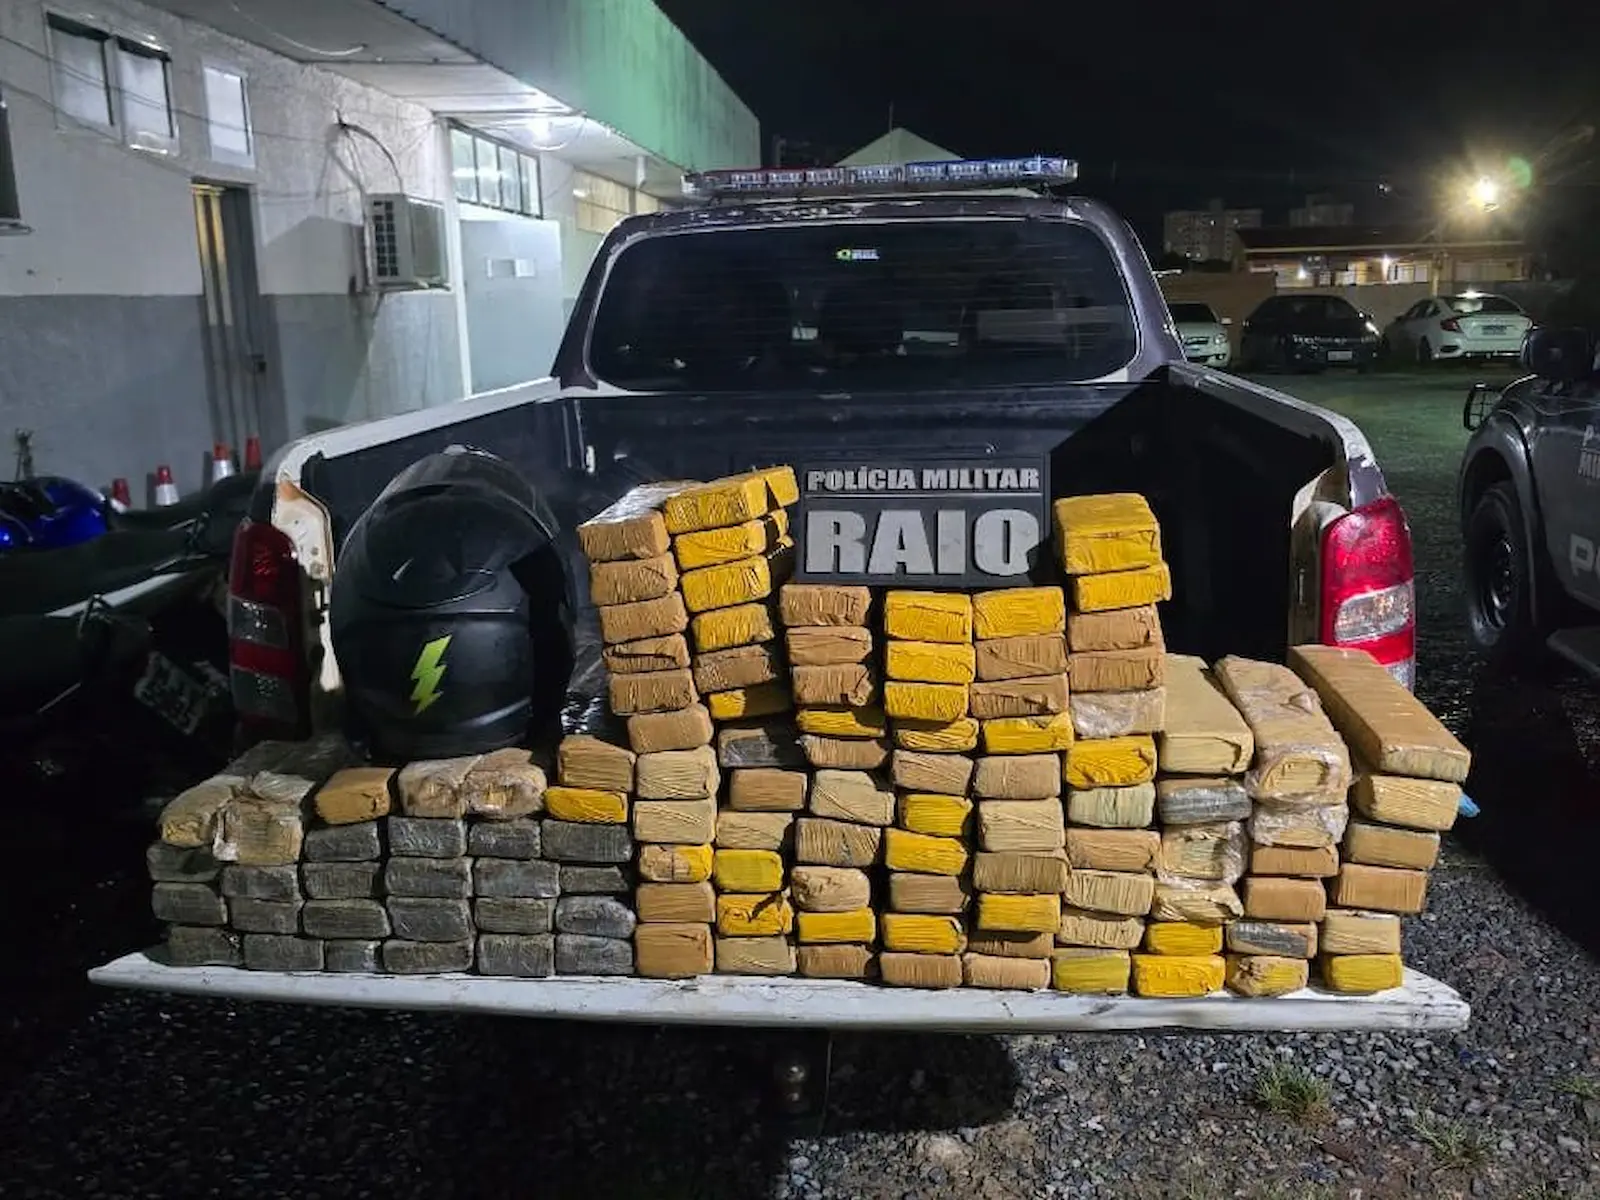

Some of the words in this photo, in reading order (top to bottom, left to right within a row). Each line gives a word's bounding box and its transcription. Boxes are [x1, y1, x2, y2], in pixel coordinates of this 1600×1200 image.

[808, 466, 917, 491] POLÍCIA
[922, 468, 1040, 490] MILITAR
[805, 508, 1040, 577] RAIO
[1569, 532, 1600, 581] P
